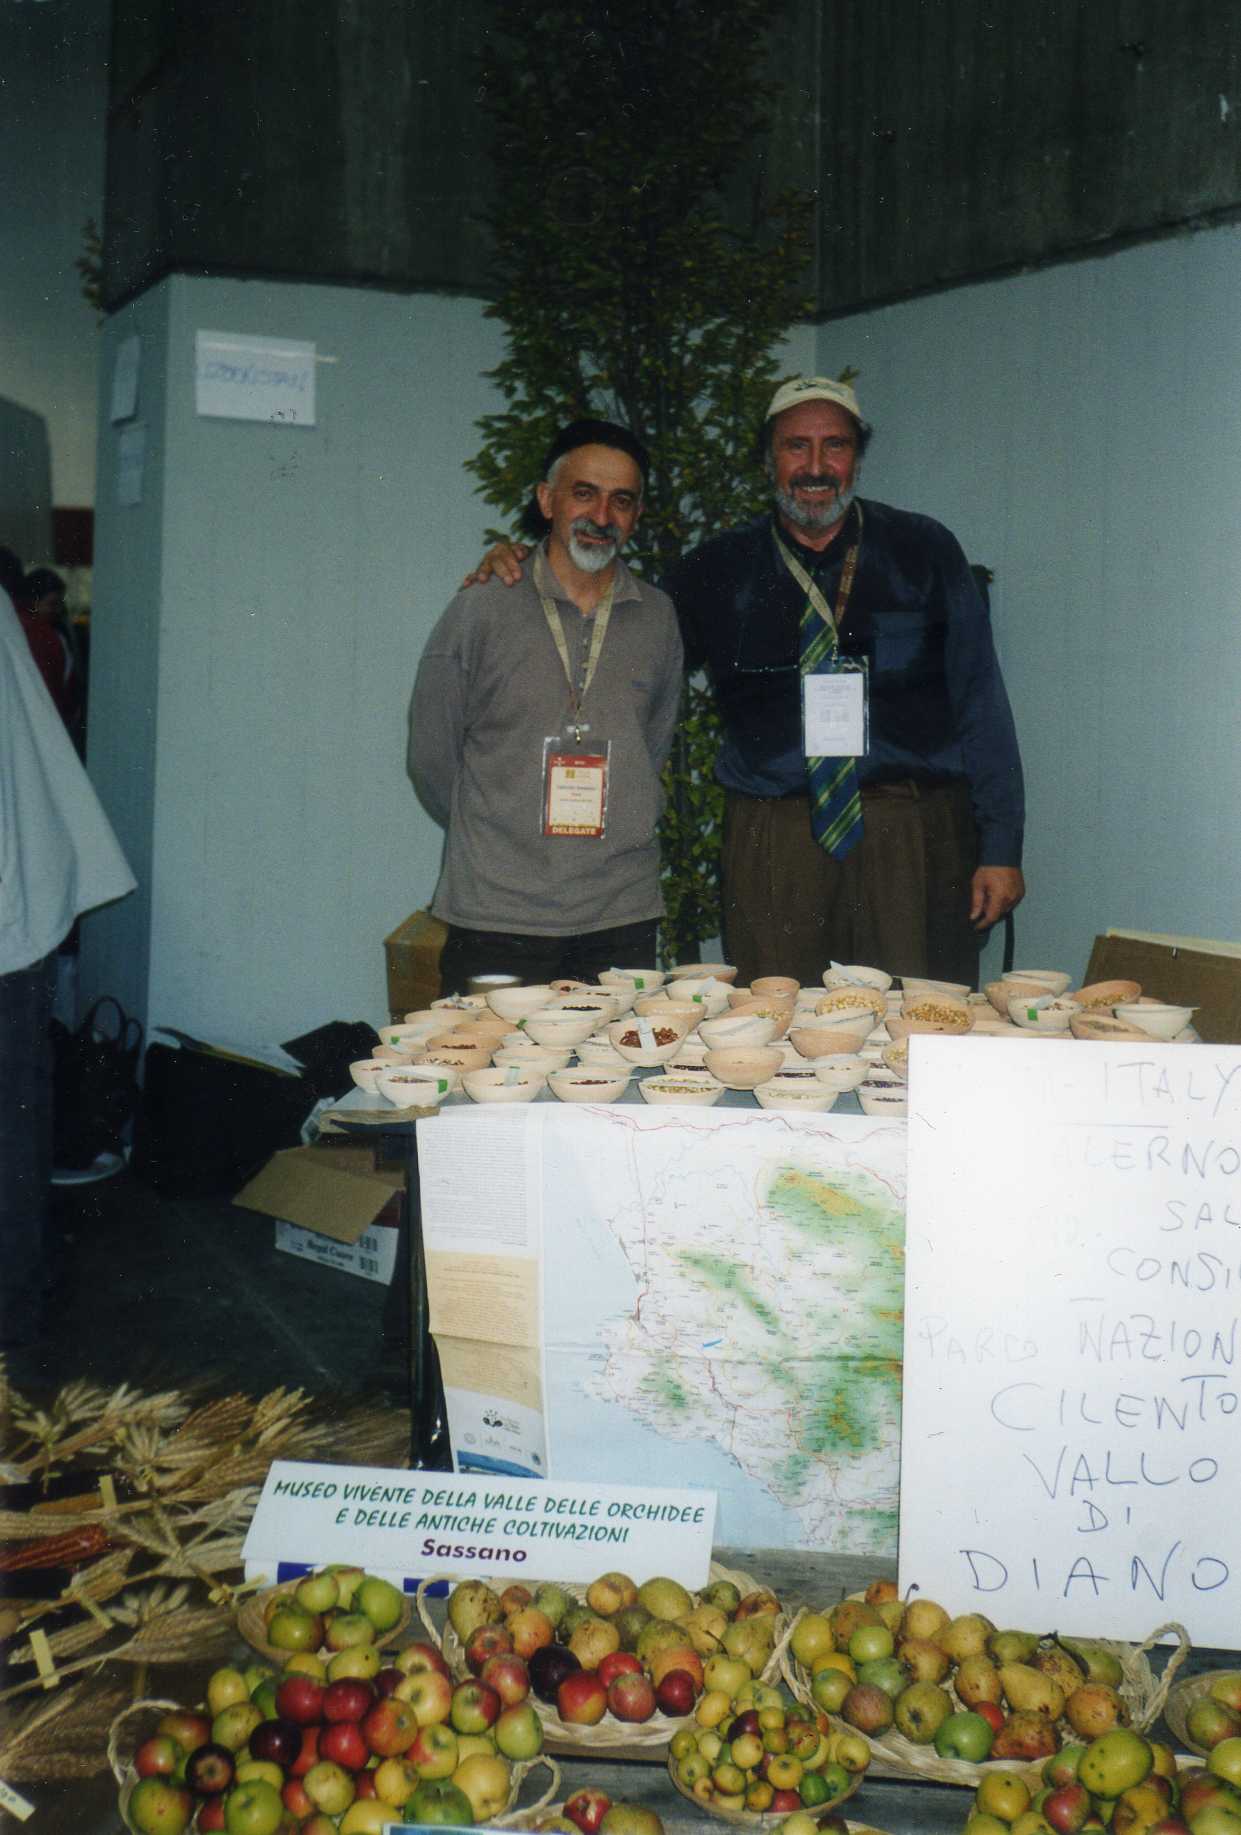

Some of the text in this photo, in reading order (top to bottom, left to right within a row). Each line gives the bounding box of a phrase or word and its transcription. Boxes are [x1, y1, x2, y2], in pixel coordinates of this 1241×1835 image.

[552, 826, 596, 835] DELEGATE
[1104, 1061, 1241, 1117] ITALY
[1106, 1246, 1241, 1292] CONSI
[991, 1375, 1239, 1431] CILENTO
[1022, 1445, 1218, 1499] VALLO
[274, 1480, 705, 1523] MUSEO VIVENTE DELLA VALLE DELLE ORCHIDEE
[1077, 1500, 1132, 1532] DI
[335, 1508, 630, 1544] E DELLE ANTICHE COLTIVAZIONI
[421, 1538, 527, 1562] Sassano
[958, 1540, 1230, 1601] DIANO
